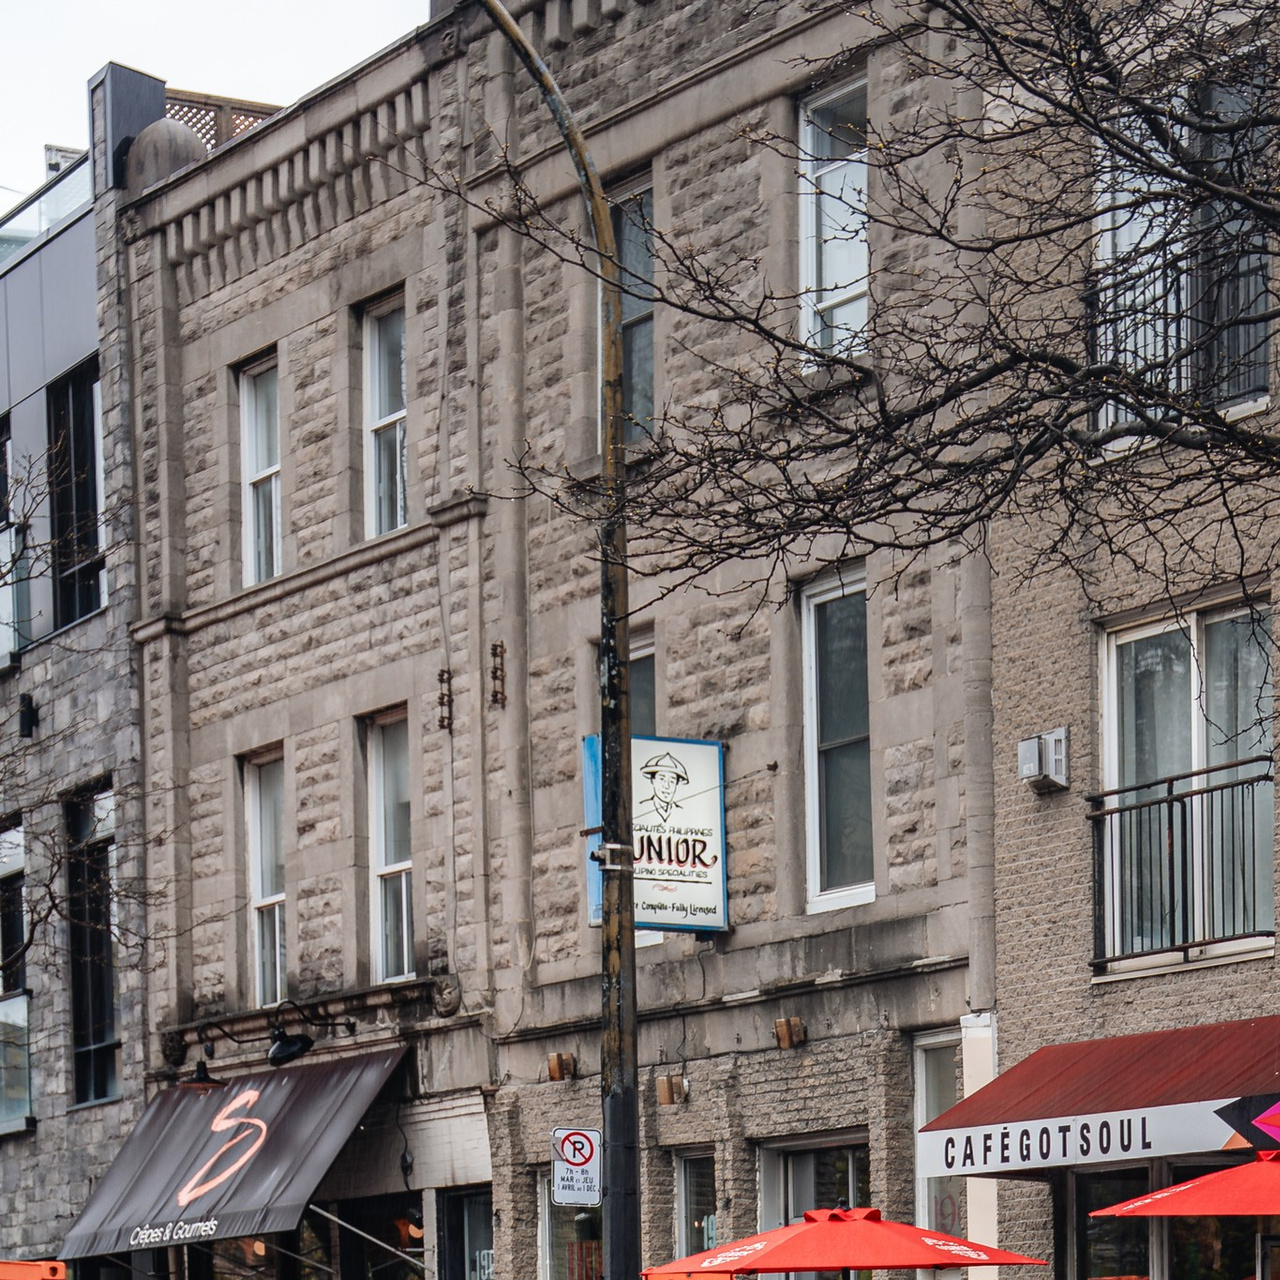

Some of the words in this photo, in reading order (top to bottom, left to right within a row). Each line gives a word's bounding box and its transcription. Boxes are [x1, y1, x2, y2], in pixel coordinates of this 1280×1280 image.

[658, 868, 708, 879] SPECIALITIES
[565, 1167, 574, 1175] 7h
[580, 1168, 589, 1176] 8h
[581, 1176, 594, 1184] JEU
[129, 1223, 164, 1247] Crêpes
[163, 1222, 173, 1241] &
[172, 1217, 218, 1240] Gourmets
